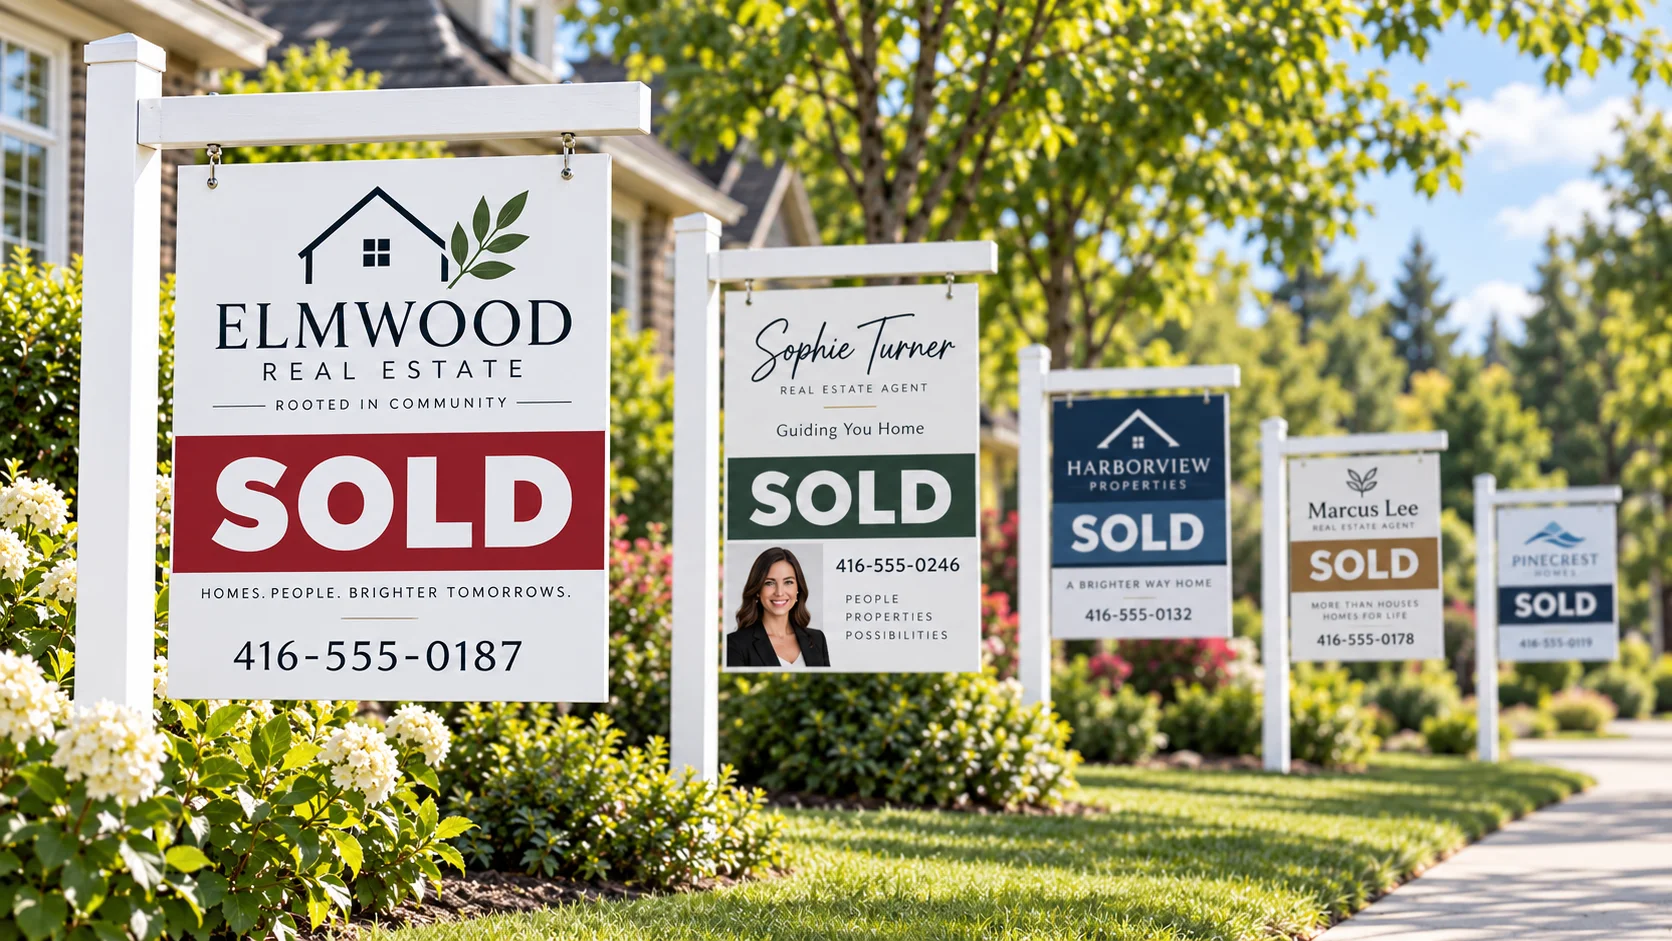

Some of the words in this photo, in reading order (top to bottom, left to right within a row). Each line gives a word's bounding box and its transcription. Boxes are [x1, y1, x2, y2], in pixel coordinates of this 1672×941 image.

[215, 299, 572, 350] ELMWOOD
[751, 318, 855, 382] Sophie
[857, 313, 956, 375] Turner
[263, 361, 356, 381] REAL
[382, 359, 524, 380] ESTATE
[781, 386, 814, 395] REAL
[823, 384, 873, 394] ESTATE
[881, 383, 928, 393] AGENT
[275, 399, 350, 411] ROOTED
[360, 399, 378, 410] IN
[389, 396, 507, 410] COMMUNITY
[777, 423, 837, 439] Guiding
[843, 423, 872, 436] You
[878, 422, 924, 435] Home
[1067, 458, 1210, 476] HARBORVIEW
[1090, 480, 1187, 491] PROPERTIES
[211, 455, 572, 552] SOLD
[749, 470, 952, 526] SOLD
[1308, 501, 1379, 519] Marcus
[1385, 500, 1419, 517] Lee
[1071, 513, 1204, 553] SOLD
[1341, 523, 1376, 531] ESTATE
[836, 557, 960, 573] 416-555-0246
[1309, 548, 1419, 582] SOLD
[1512, 553, 1598, 567] PINECREST
[1534, 569, 1576, 577] HOMES
[1066, 581, 1074, 589] A
[1079, 580, 1140, 589] BRIGHTER
[1145, 579, 1171, 588] WAY
[1176, 578, 1212, 588] HOME
[201, 587, 265, 599] HOMES.
[271, 587, 341, 599] PEOPLE.
[349, 586, 438, 599] BRIGHTER
[446, 586, 572, 598] TOMORROWS.
[846, 594, 898, 604] PEOPLE
[1378, 600, 1419, 608] HOUSES
[1514, 592, 1597, 618] SOLD
[846, 612, 932, 622] PROPERTIES
[1085, 608, 1192, 622] 416-555-0132
[1387, 612, 1407, 620] LIFE
[846, 631, 948, 640] POSSIBILITIES
[1317, 633, 1414, 646] 416-555-0178
[233, 640, 523, 672] 416-555-0187
